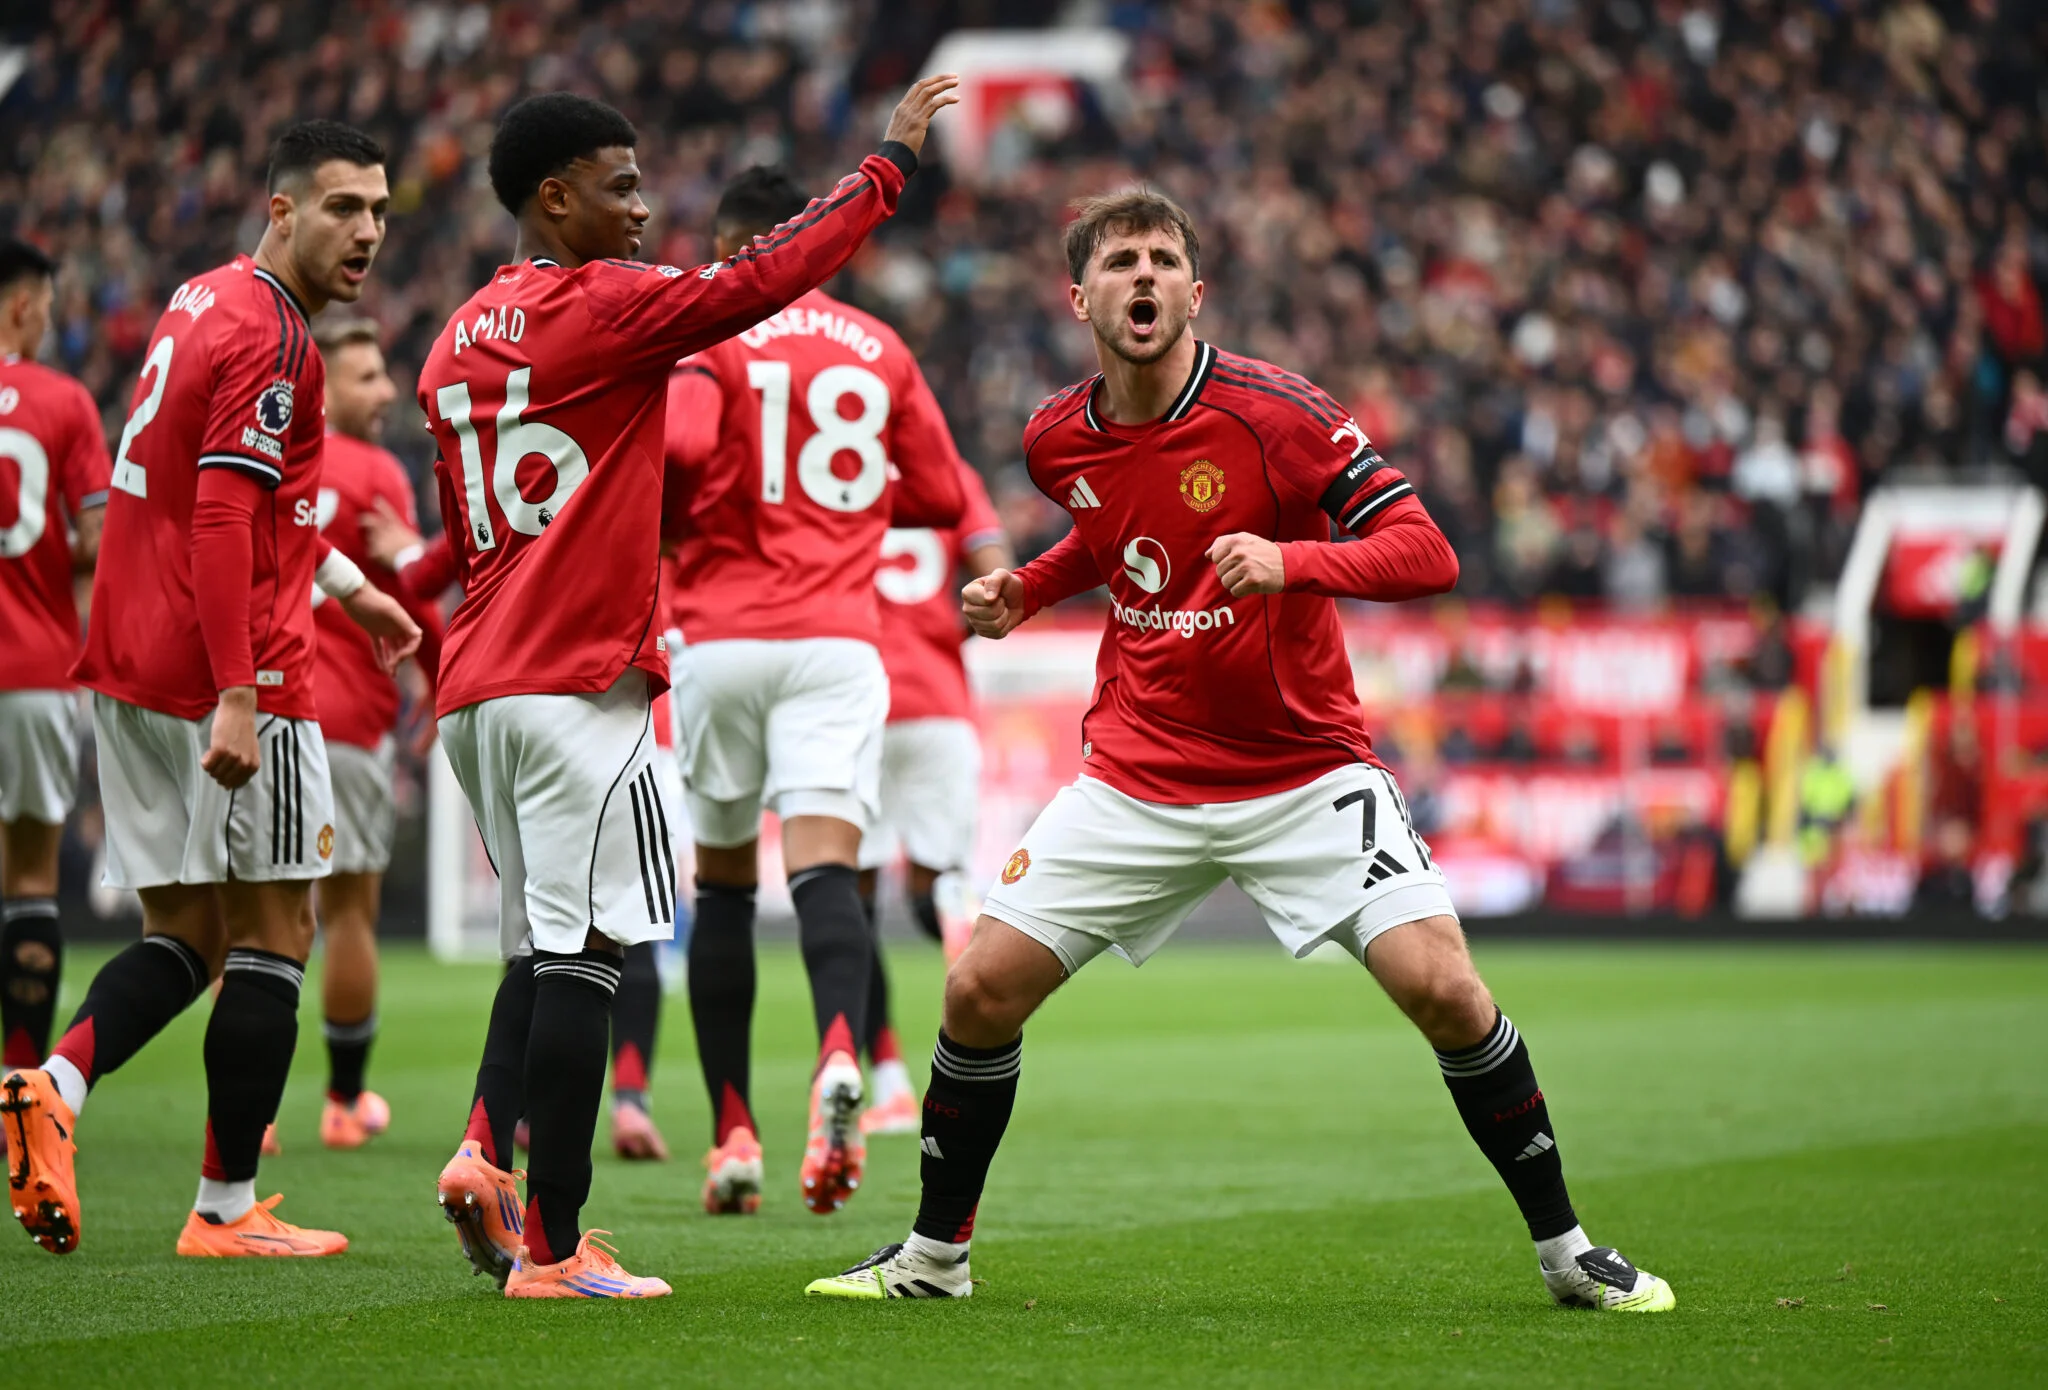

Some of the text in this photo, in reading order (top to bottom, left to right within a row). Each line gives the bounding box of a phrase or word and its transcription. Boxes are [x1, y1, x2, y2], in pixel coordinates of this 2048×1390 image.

[455, 304, 526, 356] AMAD
[110, 336, 174, 499] 2
[747, 361, 890, 513] 18
[437, 366, 590, 551] 16
[1184, 463, 1222, 480] MANCHESTER
[1190, 499, 1216, 509] UNITED
[1332, 787, 1377, 853] 7
